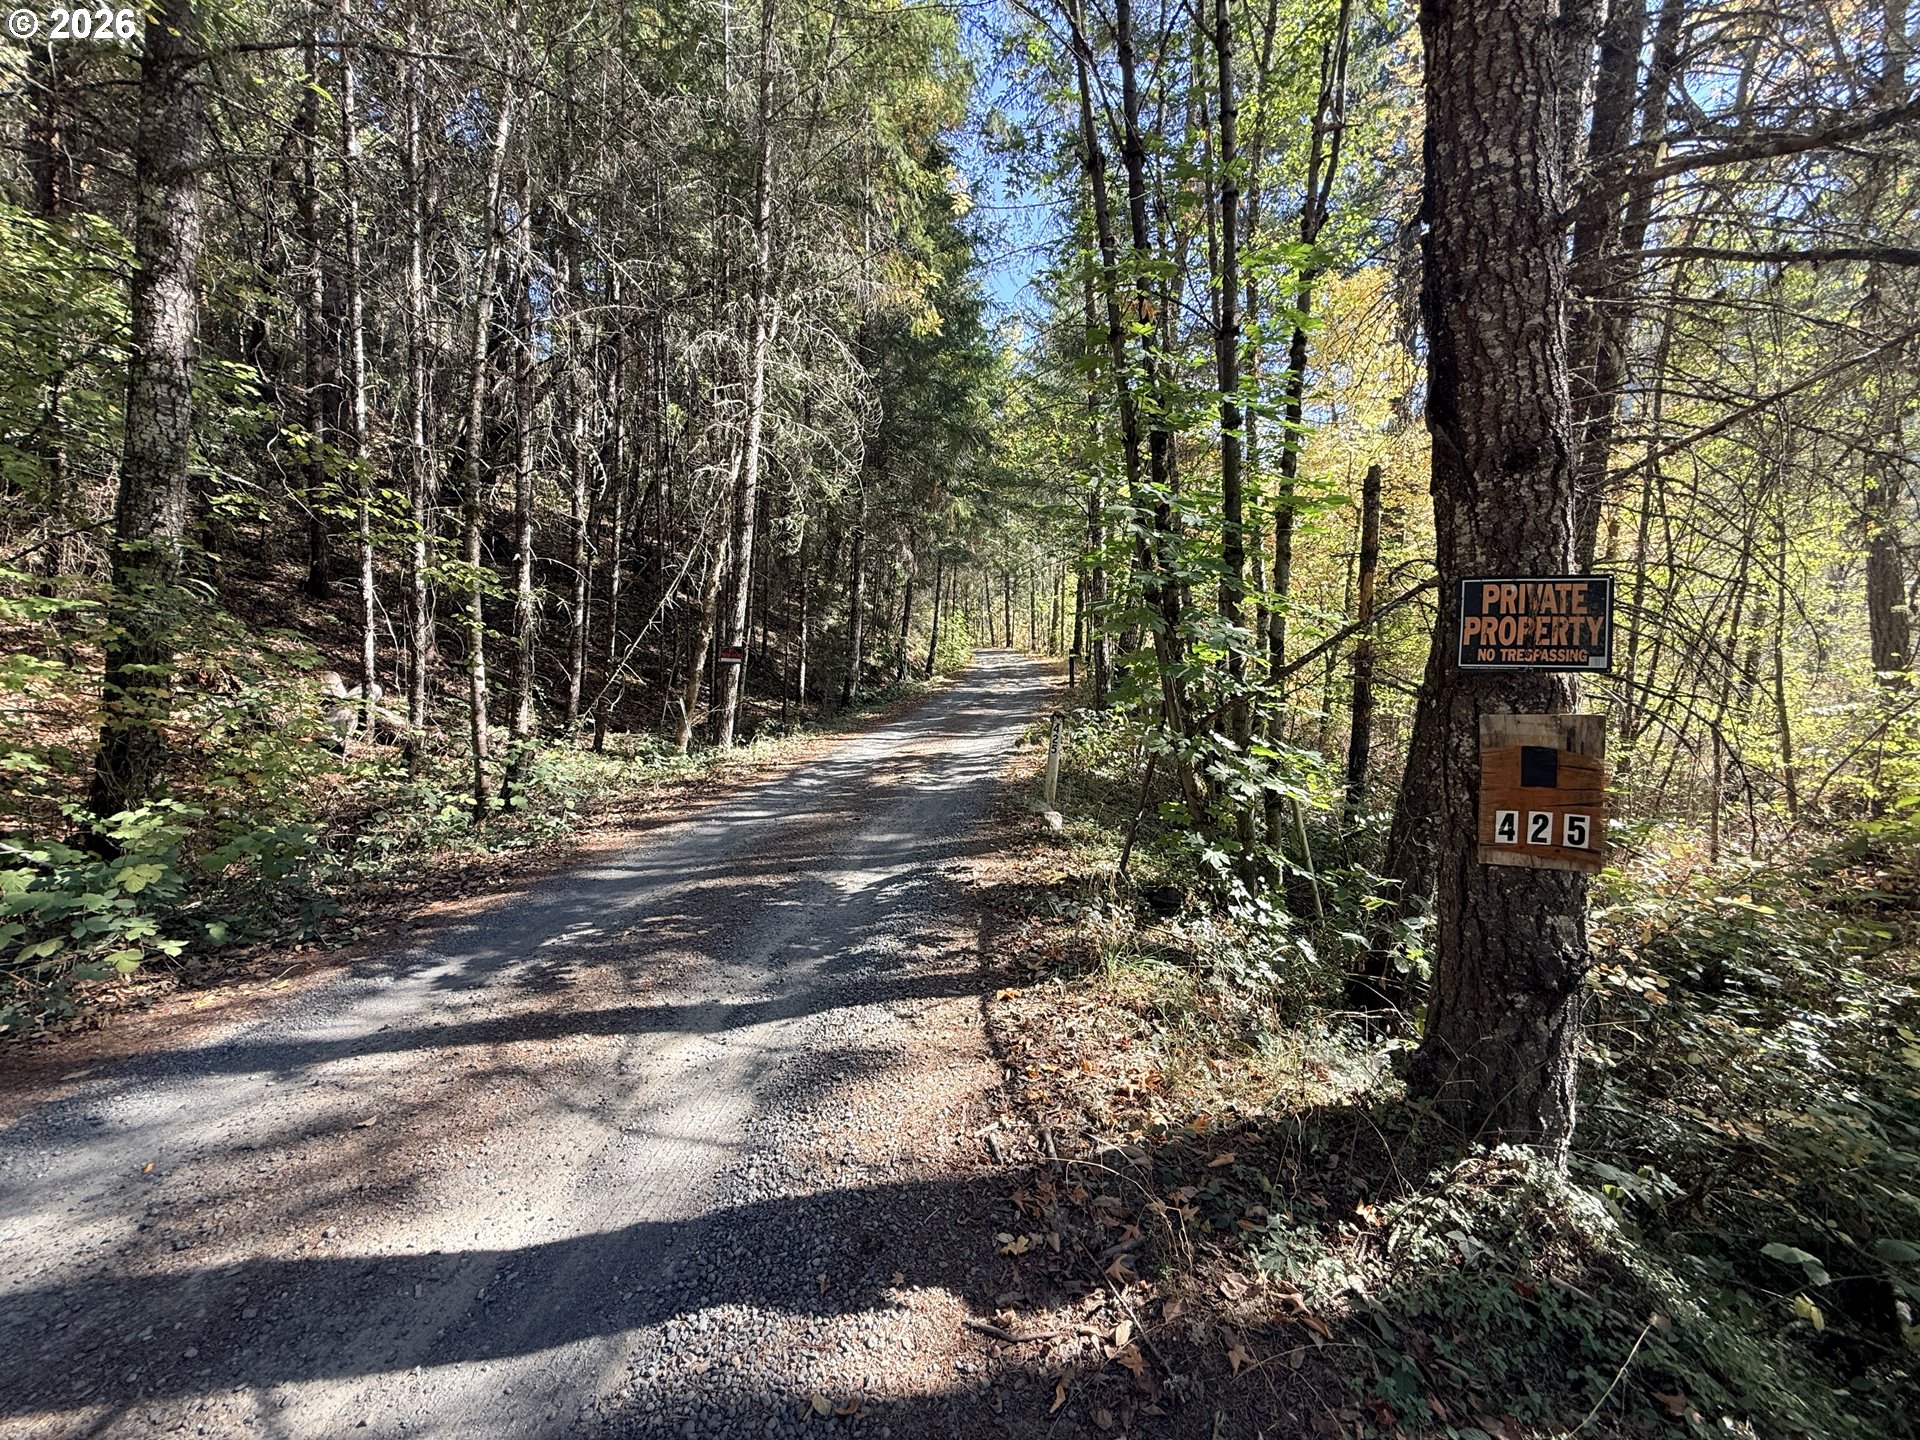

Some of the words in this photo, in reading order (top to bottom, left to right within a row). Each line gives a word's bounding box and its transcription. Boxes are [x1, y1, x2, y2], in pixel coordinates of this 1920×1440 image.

[1482, 583, 1588, 614] PRIVATE
[1463, 616, 1604, 646] PROPERTY
[1477, 649, 1496, 662] NO
[1500, 649, 1588, 662] TRESPASSING
[1051, 723, 1060, 754] 425
[1498, 813, 1586, 845] 425
